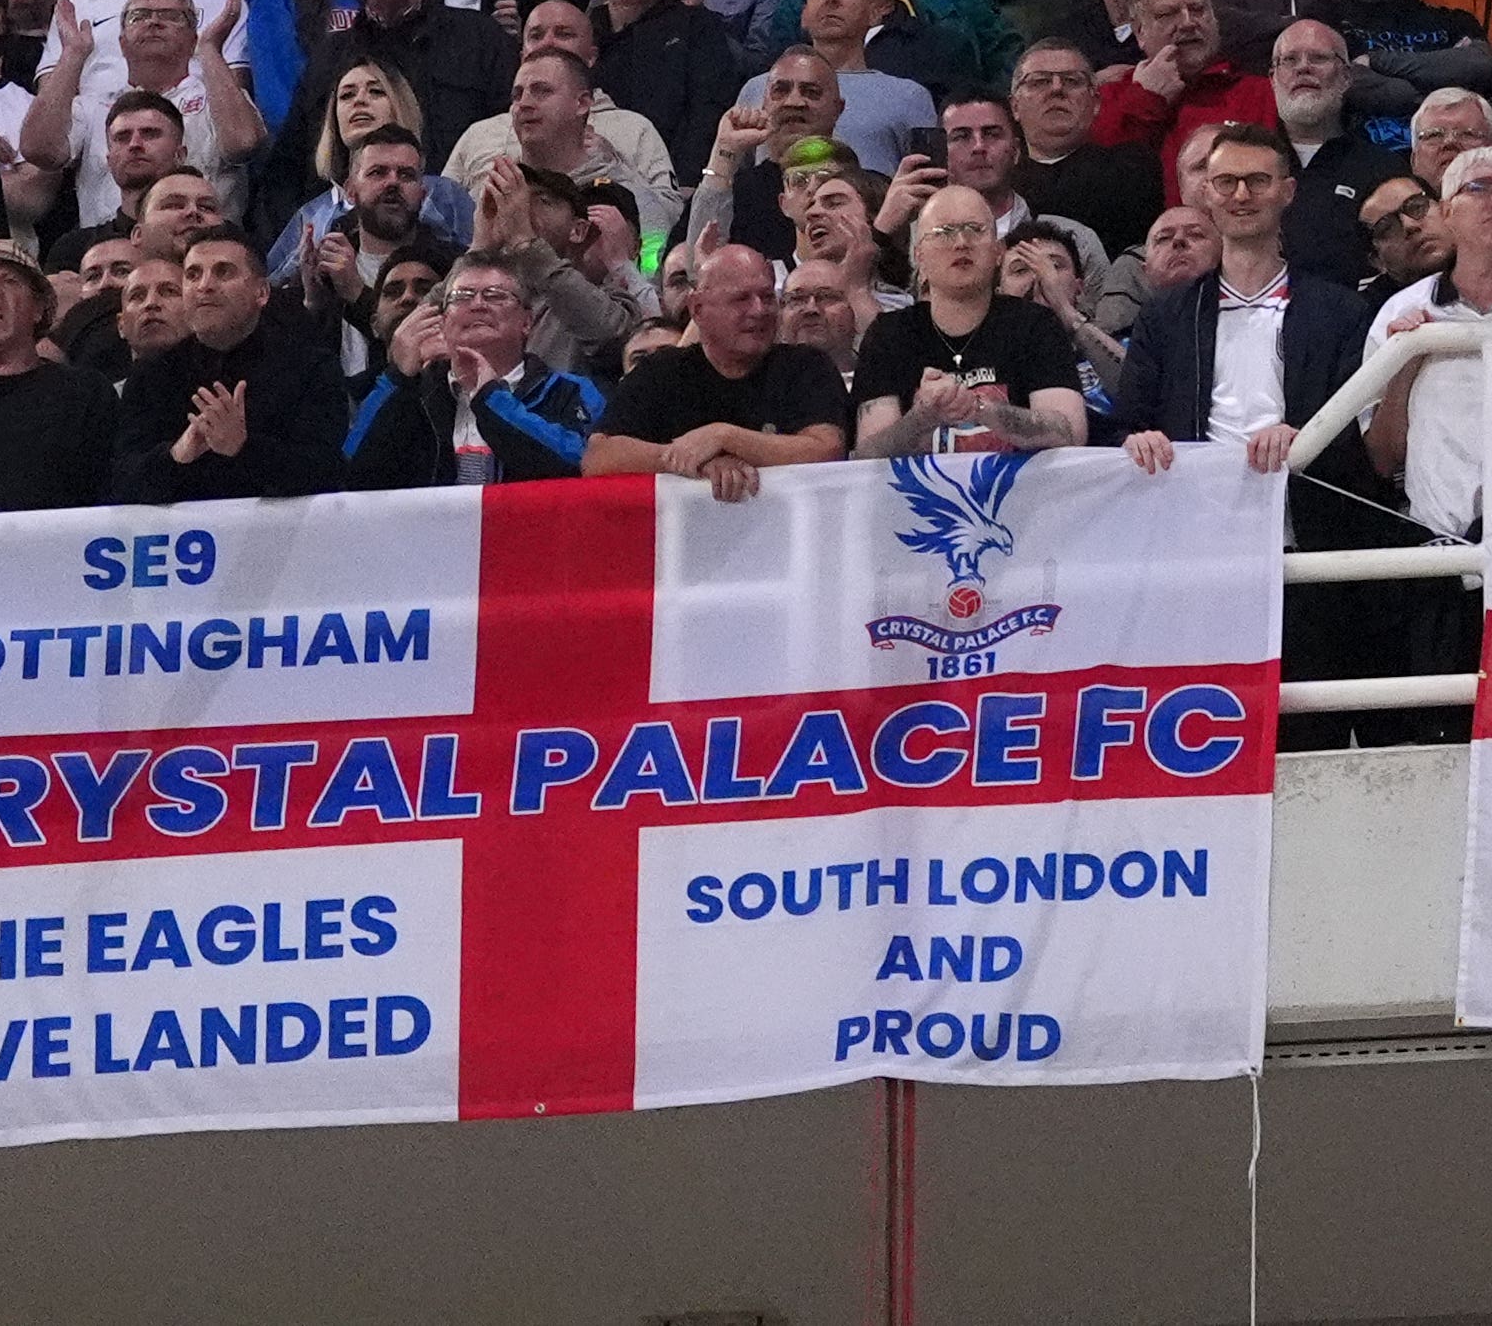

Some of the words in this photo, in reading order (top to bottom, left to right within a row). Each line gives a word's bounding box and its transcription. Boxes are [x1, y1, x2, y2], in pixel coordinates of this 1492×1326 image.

[83, 529, 217, 591] SE9
[877, 622, 949, 649] CRYSTAL
[954, 617, 1020, 652] PALACE
[926, 651, 997, 681] 1861
[510, 693, 1046, 815] PALACE
[1071, 684, 1247, 781] FC
[685, 858, 908, 924] SOUTH
[928, 849, 1209, 906] LONDON
[86, 895, 398, 974] EAGLES
[875, 935, 1024, 983] AND
[94, 994, 432, 1075] LANDED
[834, 1009, 1063, 1062] PROUD
